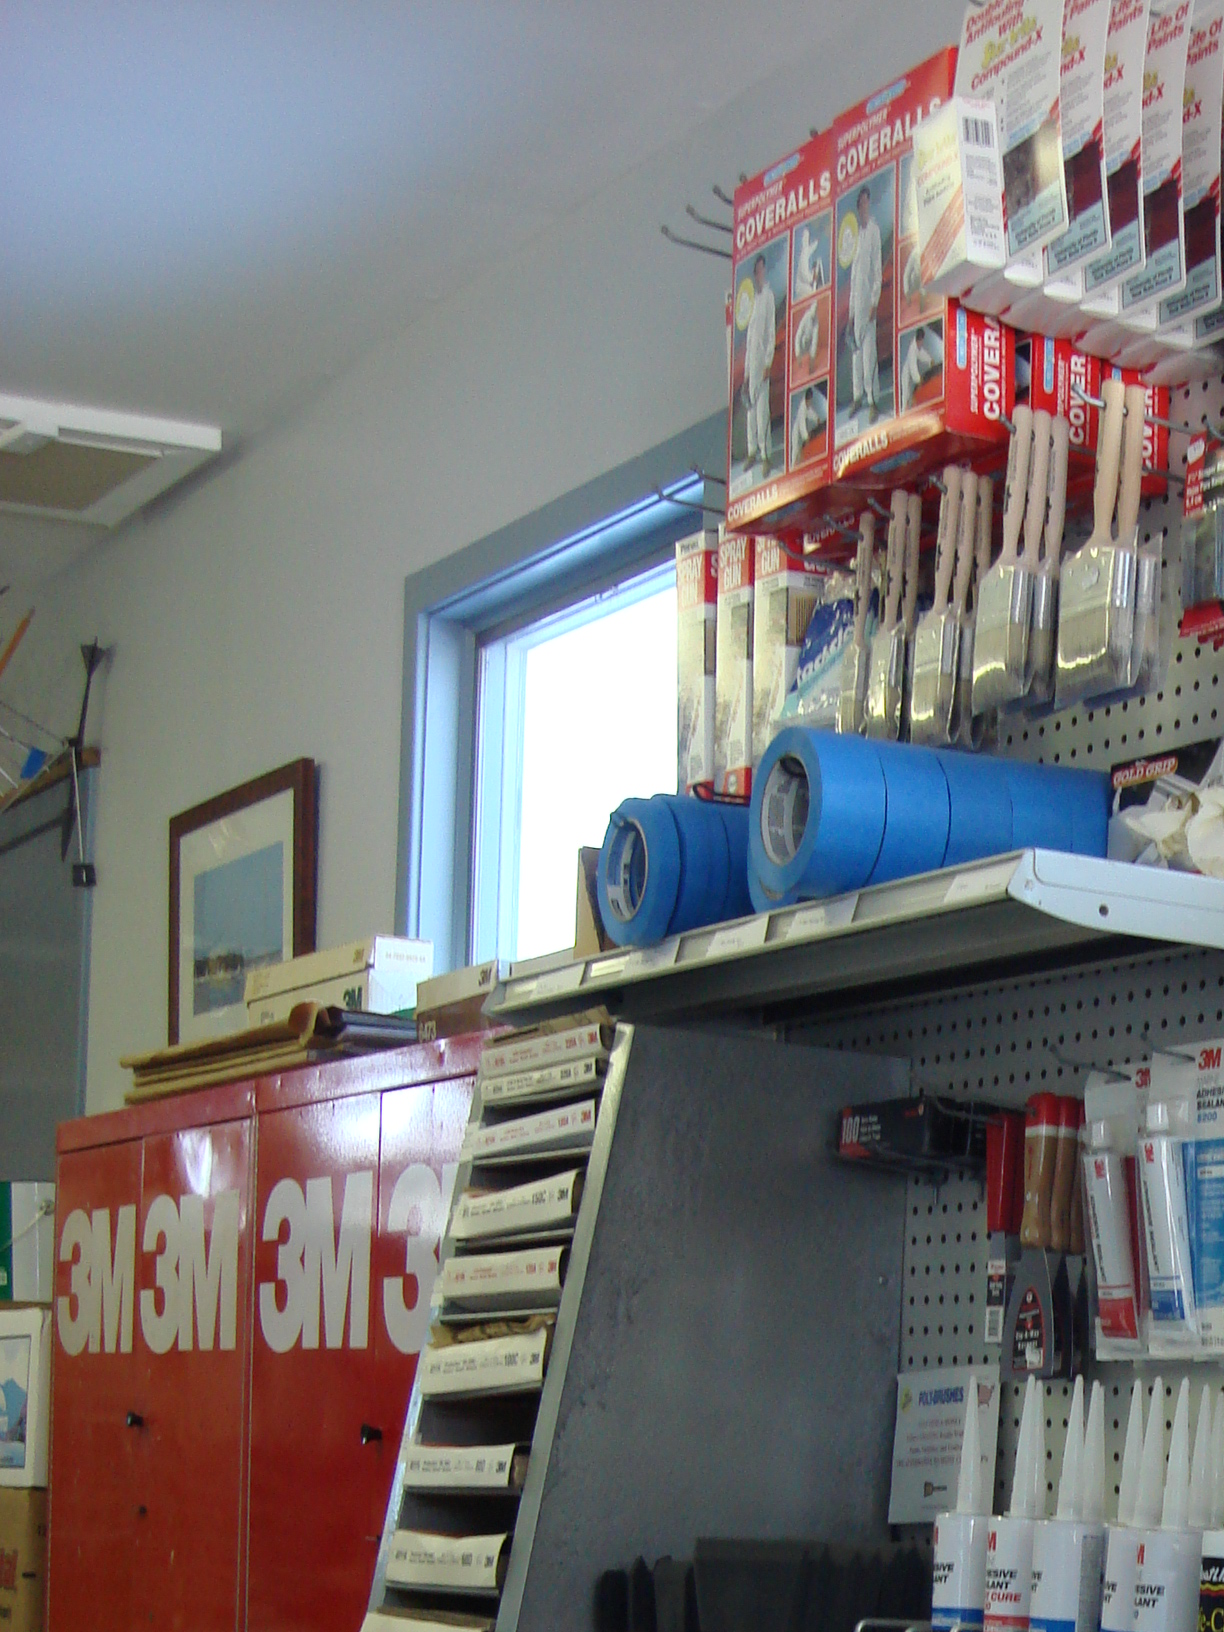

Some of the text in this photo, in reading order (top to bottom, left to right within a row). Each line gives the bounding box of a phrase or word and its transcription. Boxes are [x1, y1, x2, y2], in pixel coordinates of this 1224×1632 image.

[1147, 21, 1184, 53] Paints
[1209, 17, 1223, 37] Of
[971, 26, 1043, 90] Compound-X
[836, 97, 942, 180] COVERALLS
[736, 171, 831, 249] COVERALLS
[833, 431, 889, 470] COVERALLS
[726, 485, 778, 522] COVERALLS
[719, 535, 748, 562] SPRAY
[760, 548, 781, 573] GUN
[723, 564, 742, 588] GUN
[1112, 757, 1178, 787] GOLD GRIP
[341, 986, 364, 1011] 3M
[1197, 1046, 1222, 1070] 3M
[841, 1115, 861, 1145] 100
[57, 1189, 241, 1356] 3M 3M
[258, 1162, 460, 1355] 3M 3
[991, 1592, 1022, 1604] CURE
